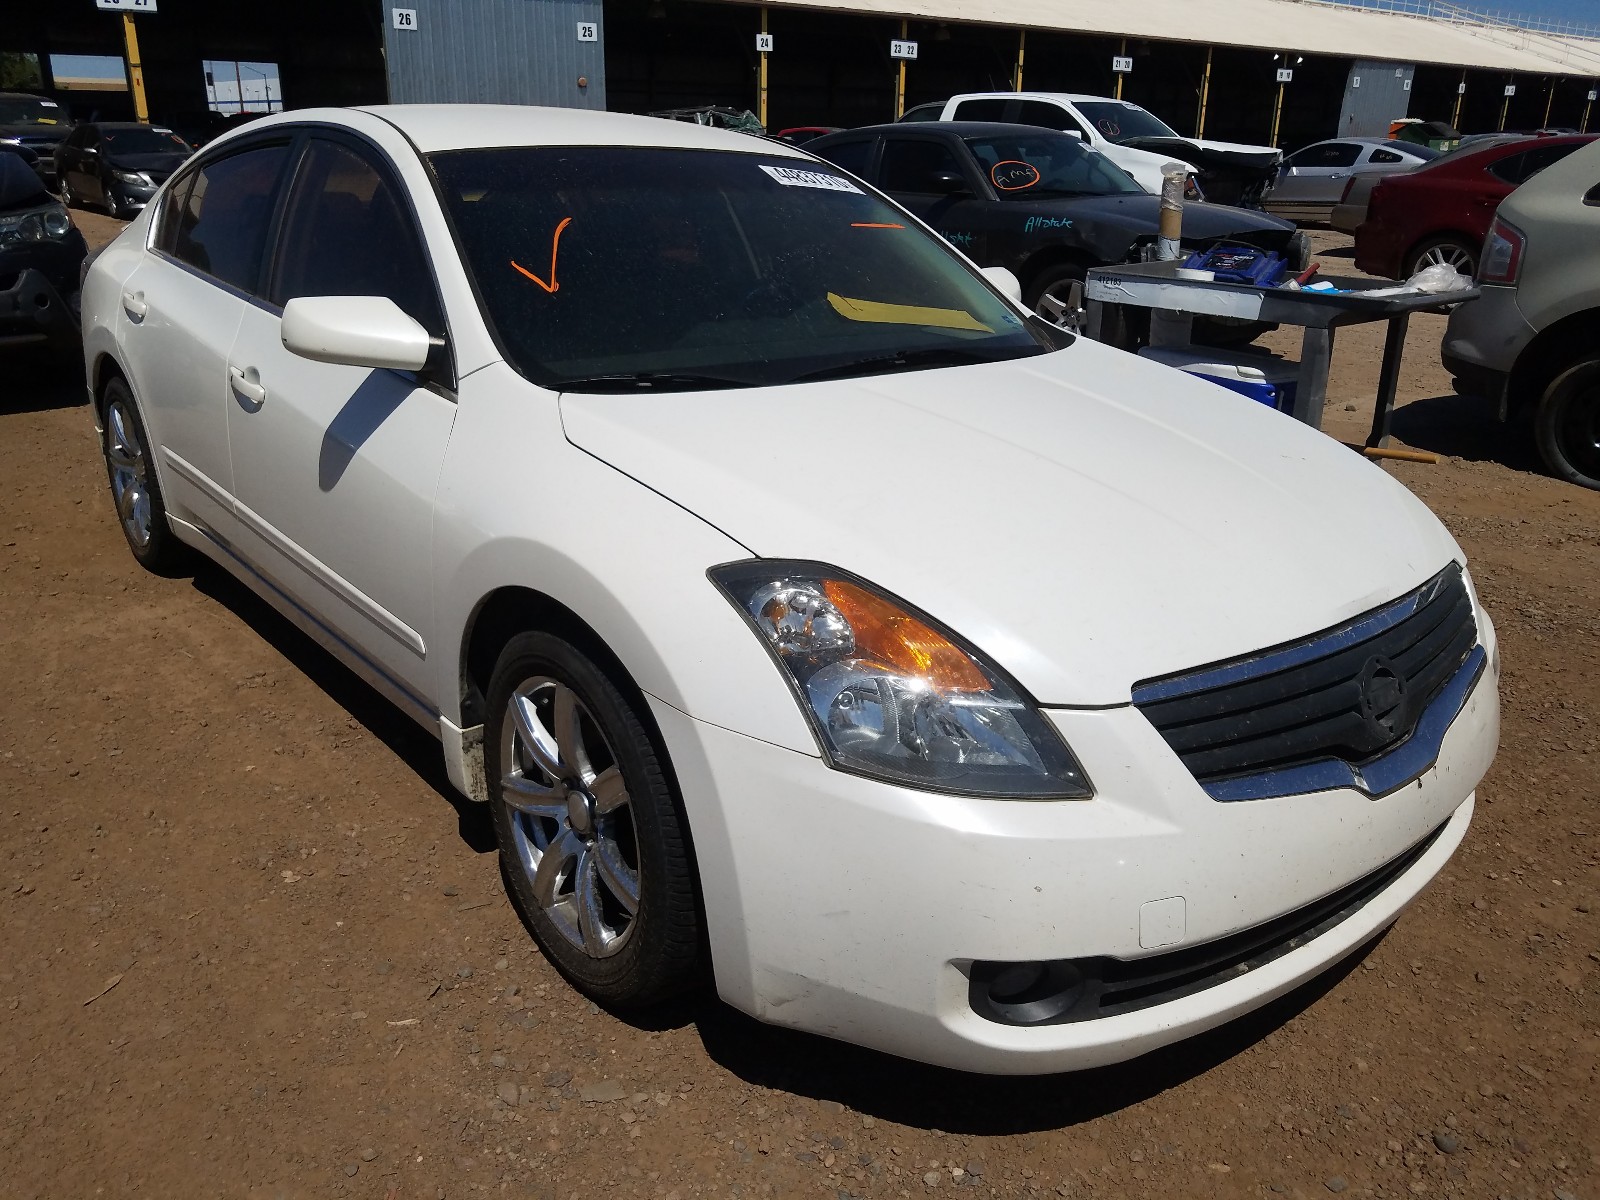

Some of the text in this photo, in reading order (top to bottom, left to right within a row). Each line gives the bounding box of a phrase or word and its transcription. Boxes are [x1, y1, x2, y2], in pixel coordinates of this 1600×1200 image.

[398, 13, 411, 25] 26
[582, 26, 593, 38] 25
[760, 38, 769, 48] 24
[894, 44, 915, 55] 23 22
[1115, 60, 1121, 68] 21
[1097, 275, 1122, 287] 412183
